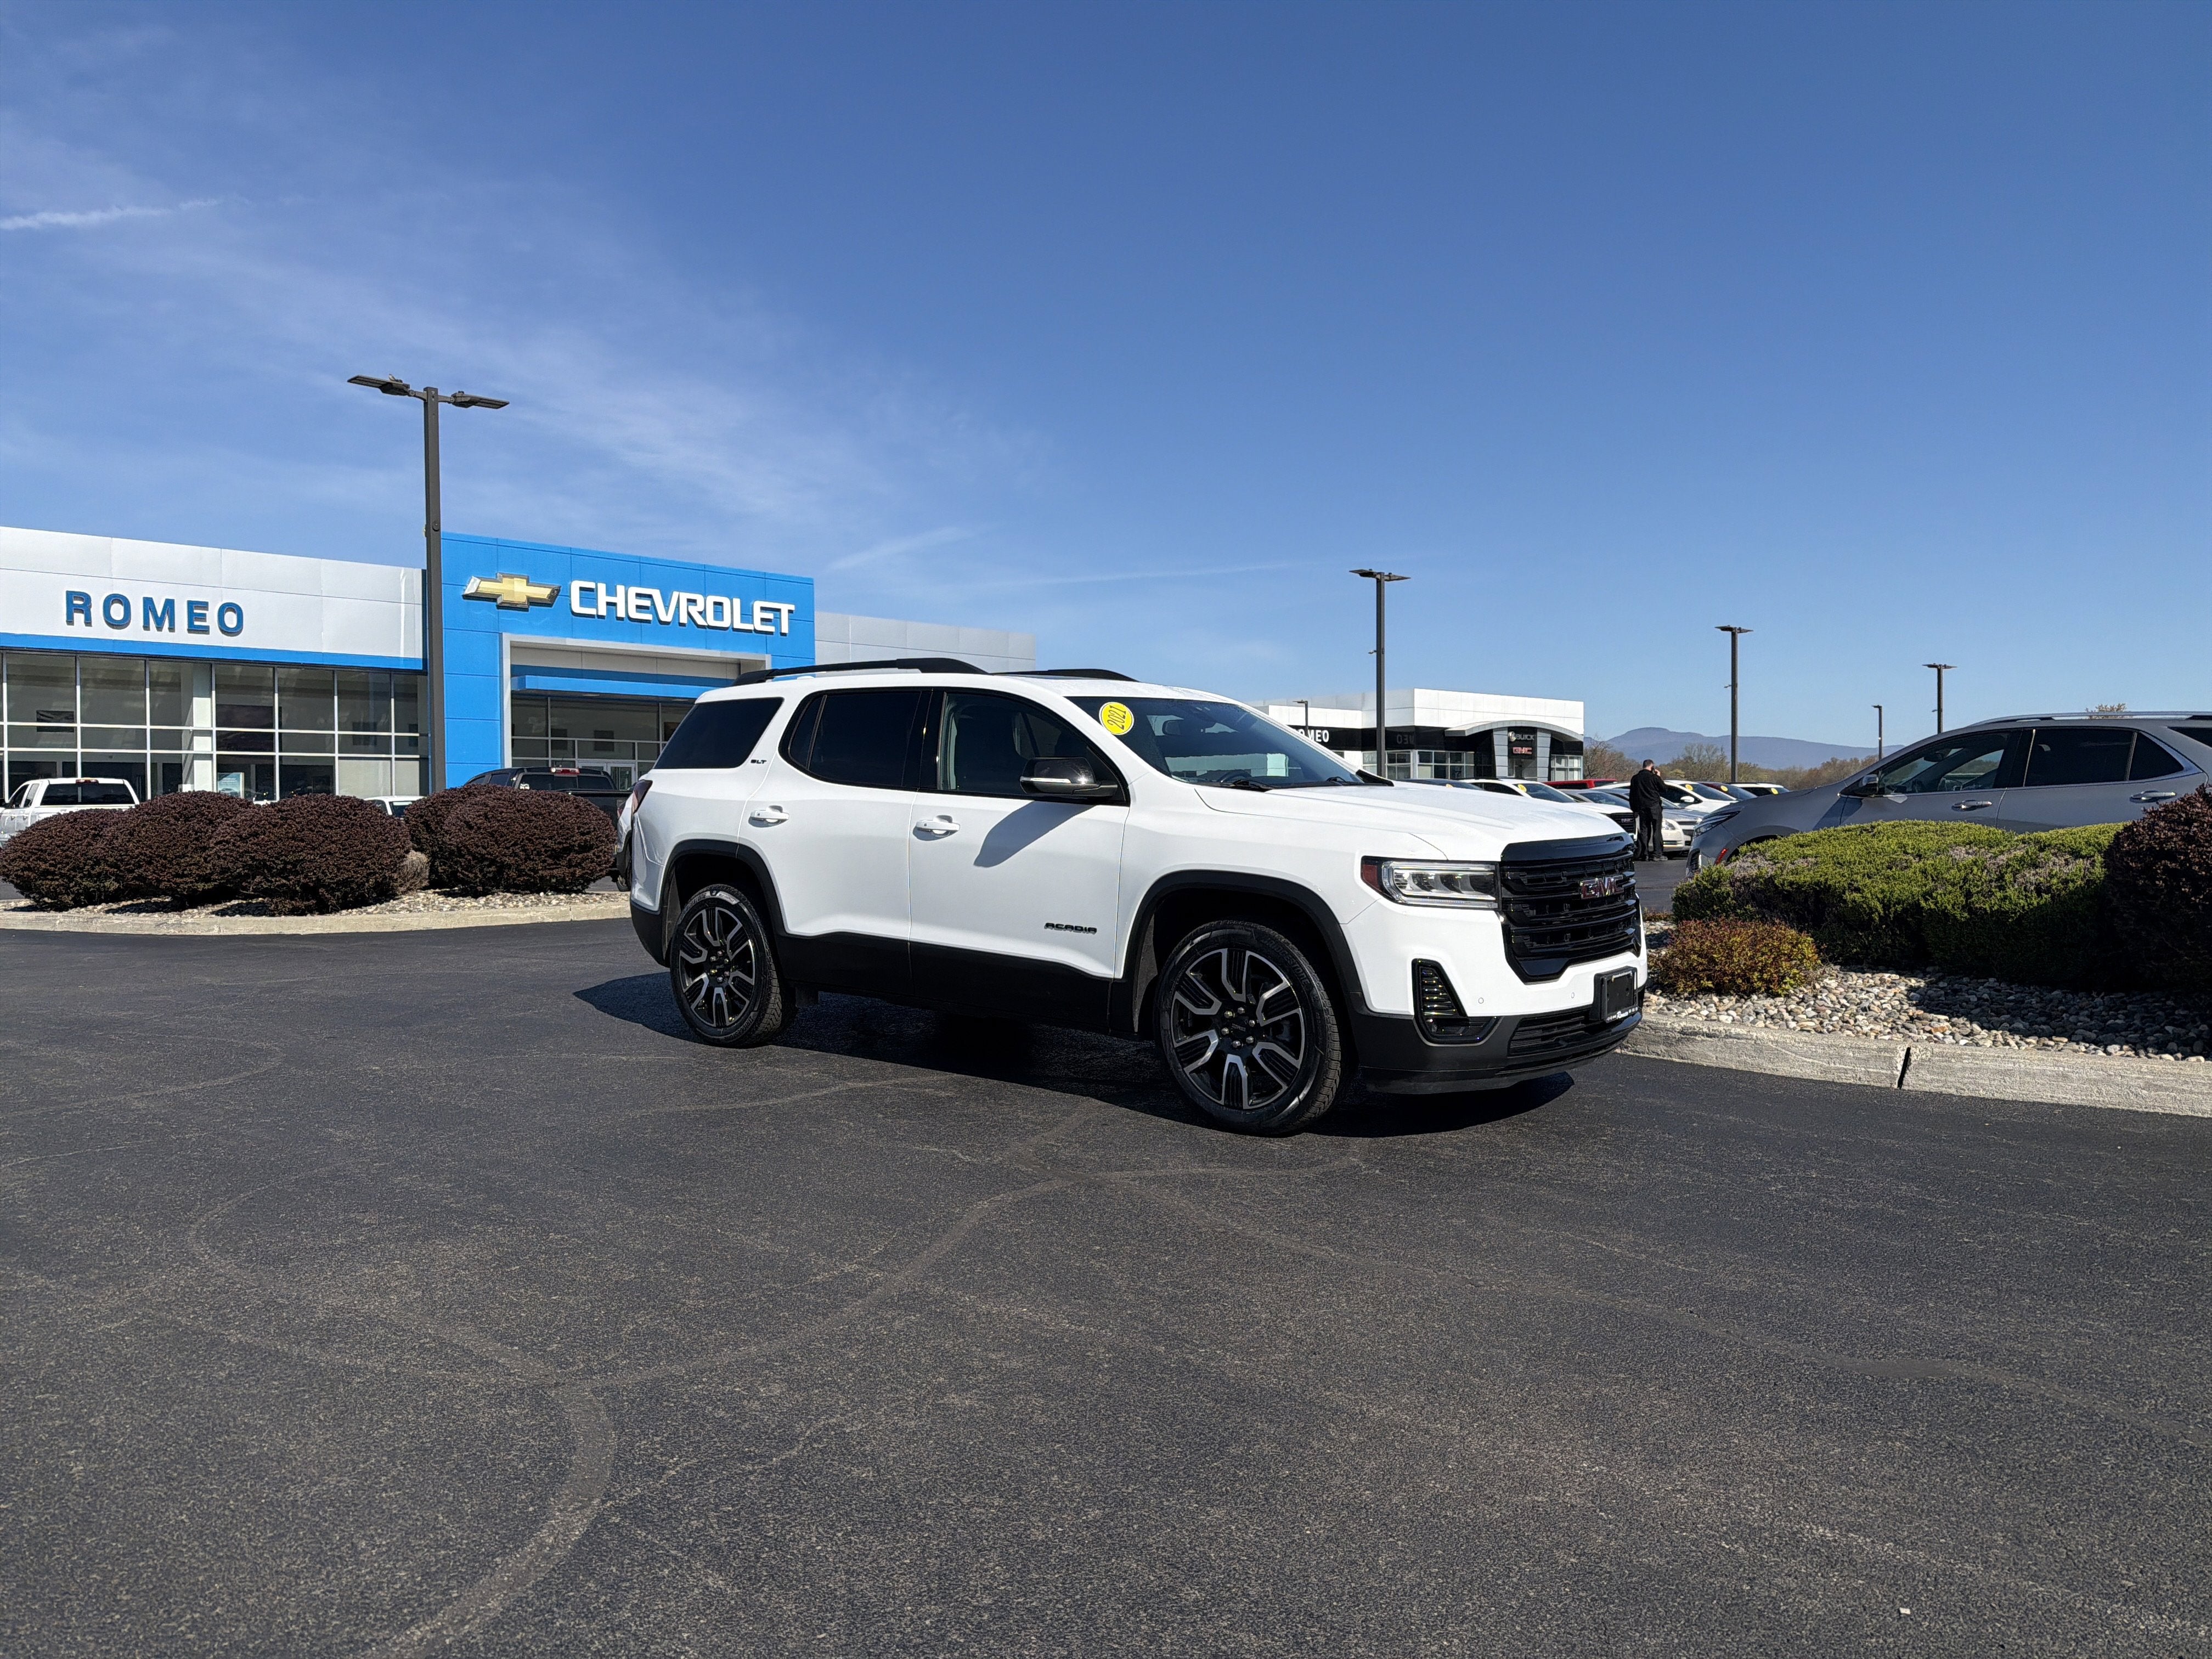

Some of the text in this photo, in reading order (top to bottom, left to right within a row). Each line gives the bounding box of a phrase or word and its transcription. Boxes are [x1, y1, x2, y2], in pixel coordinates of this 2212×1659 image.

[66, 590, 243, 636] ROMEO
[570, 580, 795, 636] CHEVROLET
[1107, 705, 1126, 730] 2021
[1298, 729, 1329, 742] MEO
[1580, 875, 1624, 899] GMC
[1044, 923, 1097, 934] ACADIA
